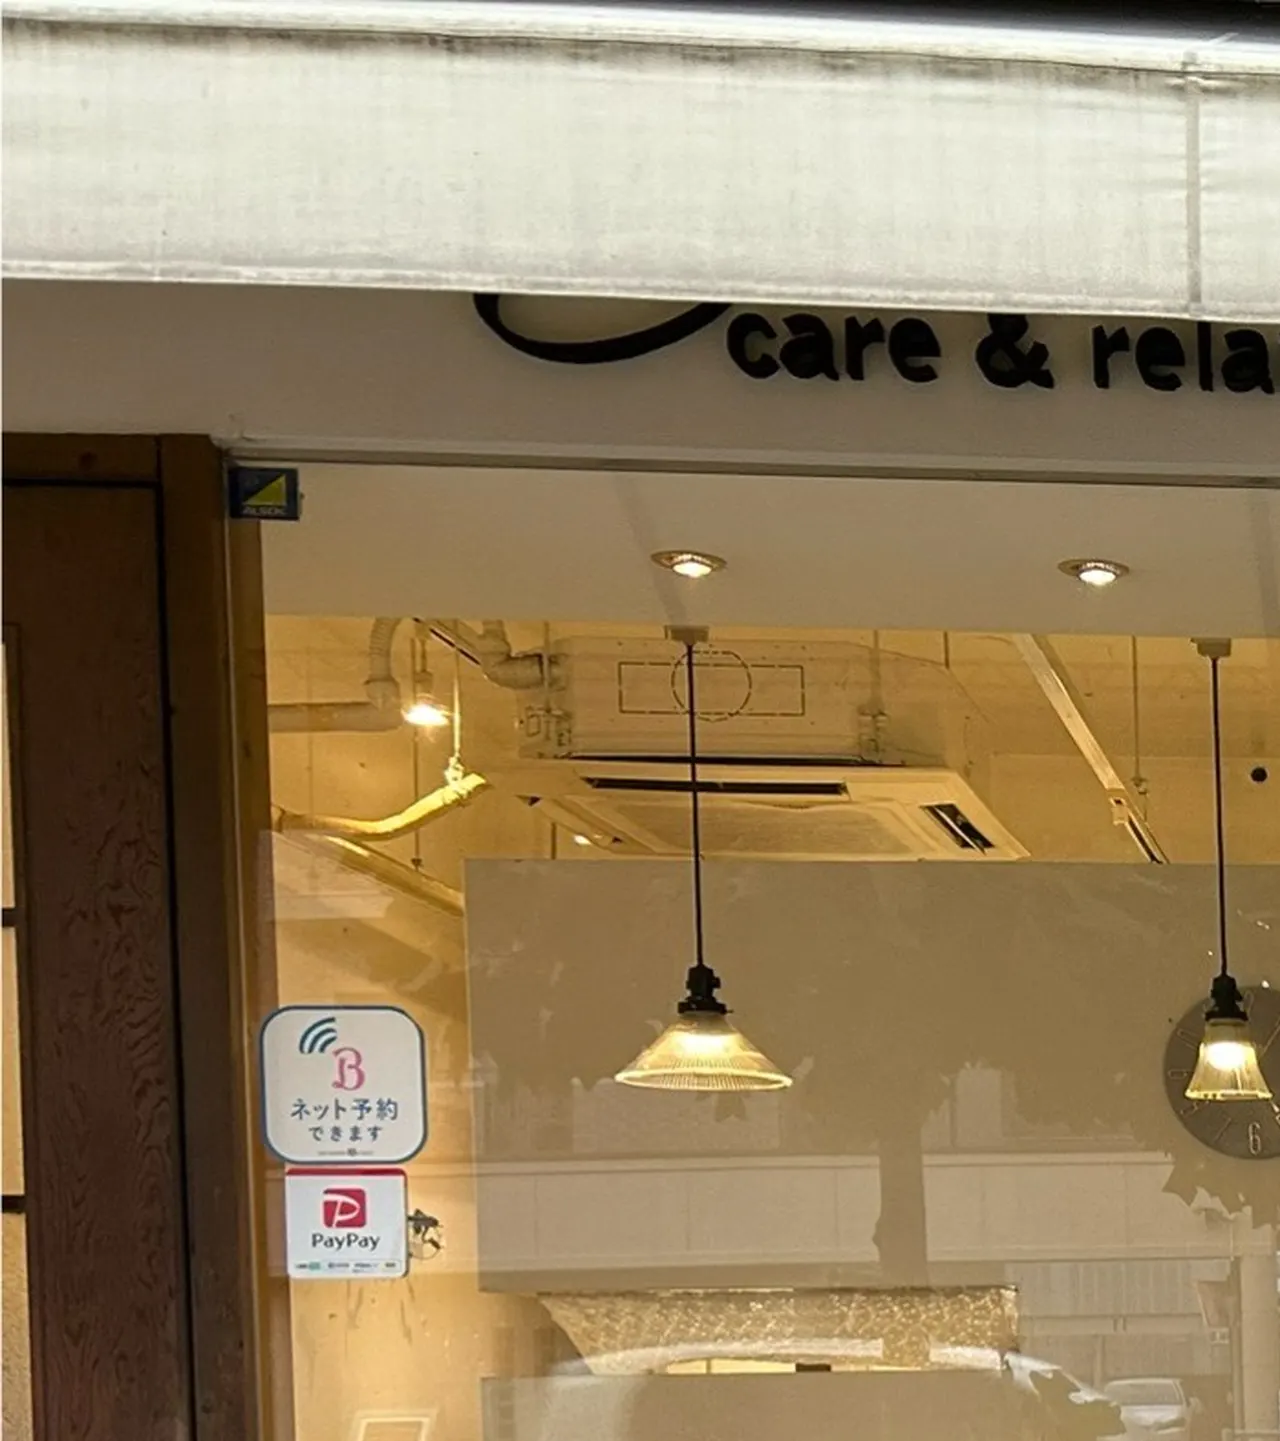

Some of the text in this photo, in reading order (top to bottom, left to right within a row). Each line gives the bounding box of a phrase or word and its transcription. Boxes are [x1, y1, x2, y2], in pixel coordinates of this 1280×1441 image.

[727, 308, 940, 385] care
[976, 314, 1053, 390] &
[290, 1097, 398, 1121] ネット予約
[308, 1126, 383, 1141] できます
[311, 1233, 380, 1251] PayPay
